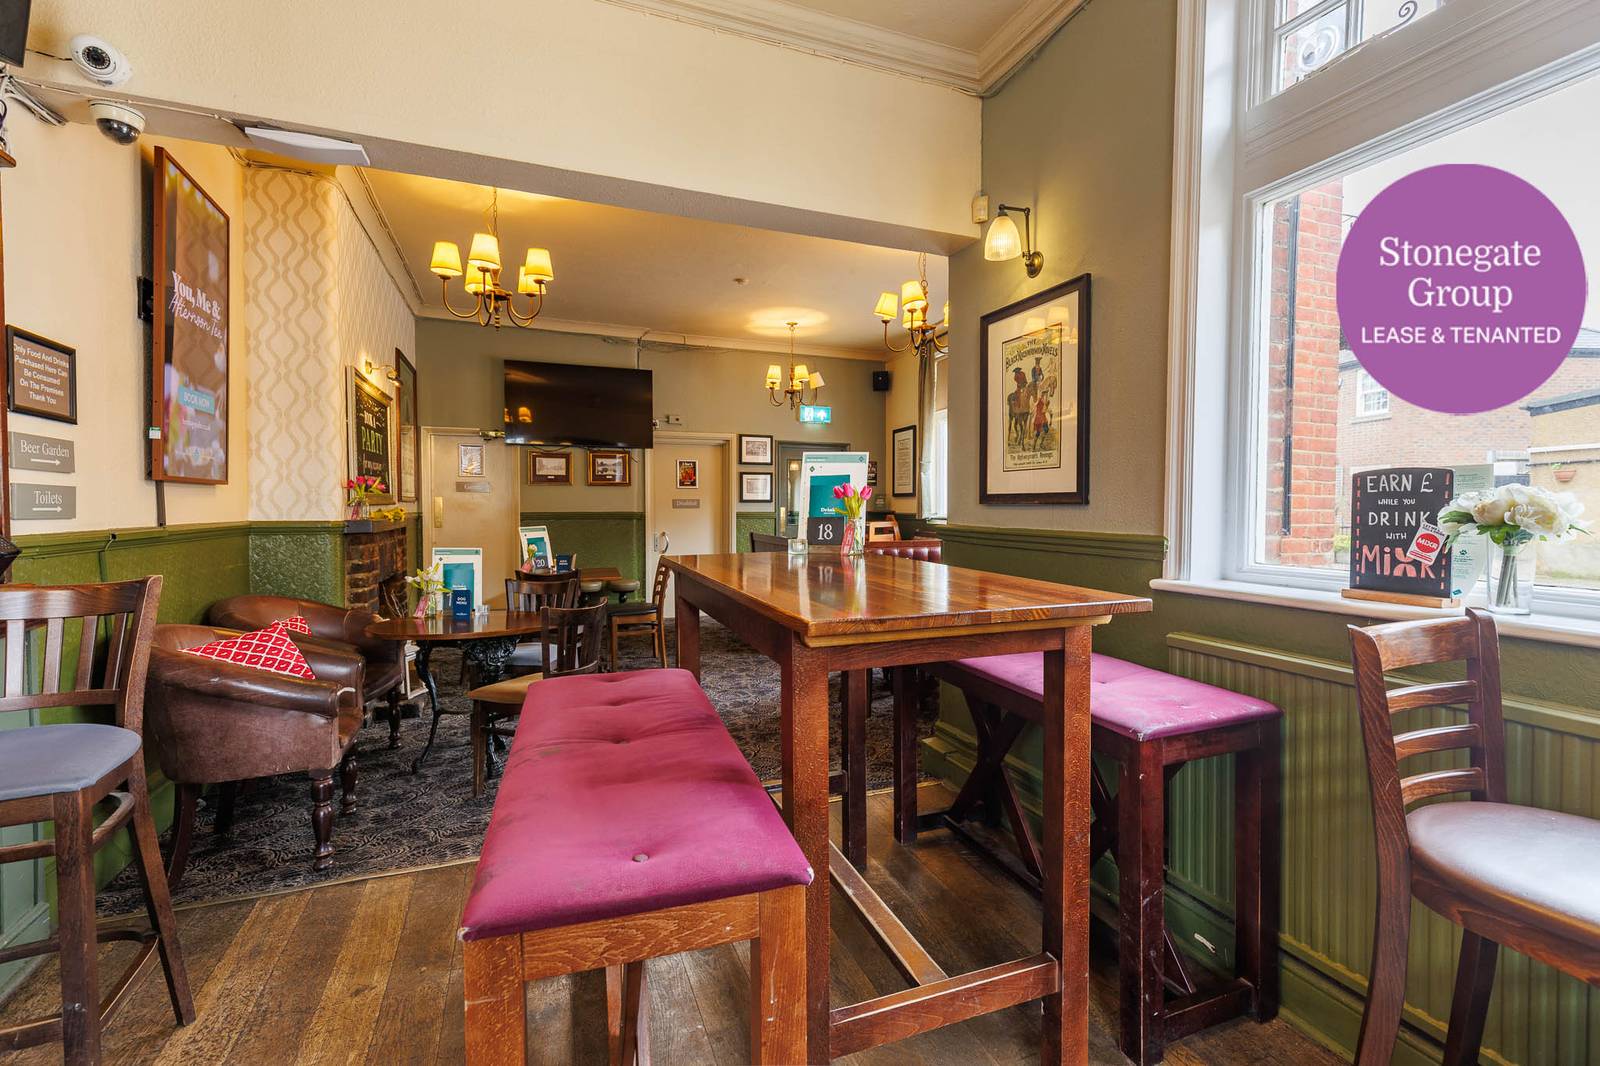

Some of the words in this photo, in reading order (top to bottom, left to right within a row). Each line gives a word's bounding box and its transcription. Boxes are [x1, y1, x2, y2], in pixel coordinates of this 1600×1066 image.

[196, 287, 211, 314] Me
[212, 300, 221, 321] &
[15, 354, 45, 371] Purchased
[27, 347, 41, 359] Food
[41, 353, 53, 363] And
[23, 368, 32, 378] Be
[32, 371, 60, 385] Consumed
[20, 377, 29, 388] On
[30, 380, 40, 390] The
[40, 384, 64, 397] Premises
[29, 391, 46, 402] Thank
[46, 395, 57, 405] You
[20, 440, 40, 454] Beer
[42, 442, 70, 457] Garden
[361, 426, 383, 455] PARTY
[1367, 474, 1412, 493] EARN
[1420, 473, 1434, 493] £
[33, 490, 63, 504] Toilets
[1368, 511, 1431, 527] DRINK
[817, 523, 834, 540] 18
[1386, 532, 1407, 540] WITH
